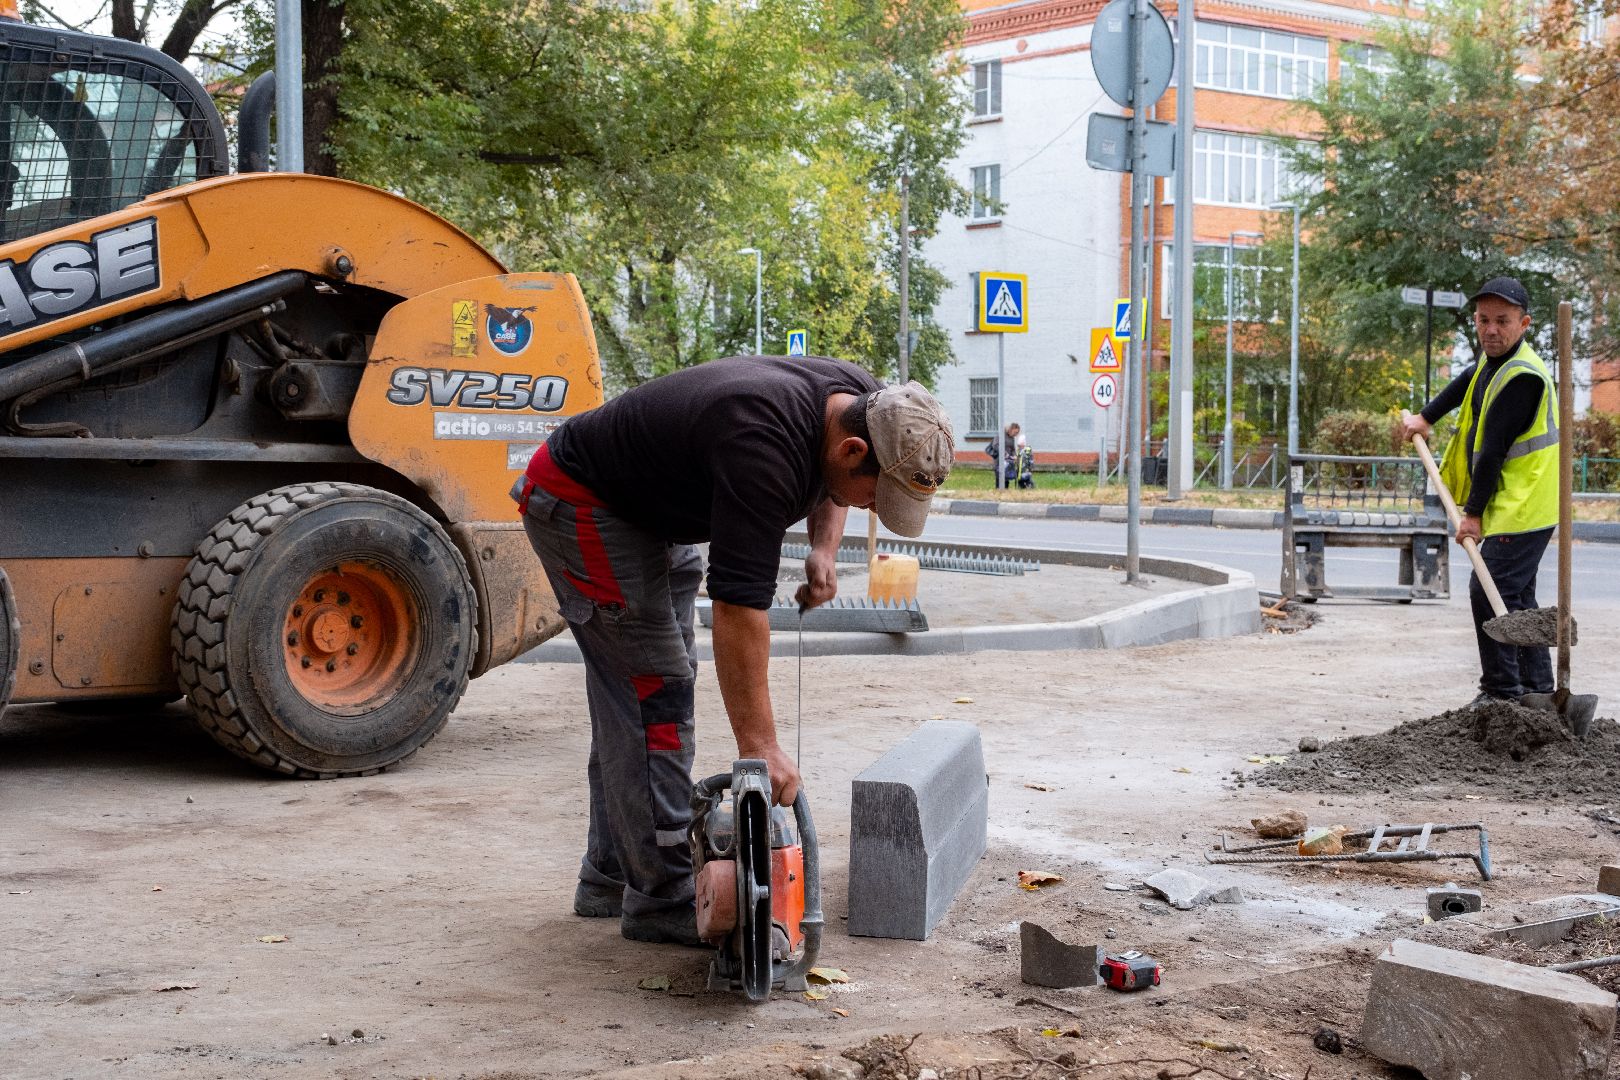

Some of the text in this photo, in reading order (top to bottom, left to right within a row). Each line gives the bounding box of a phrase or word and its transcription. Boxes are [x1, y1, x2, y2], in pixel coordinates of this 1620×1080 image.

[387, 366, 569, 412] SV250
[1097, 384, 1112, 398] 40
[436, 415, 491, 436] actio
[494, 422, 515, 433] (495)
[517, 420, 533, 434] 54
